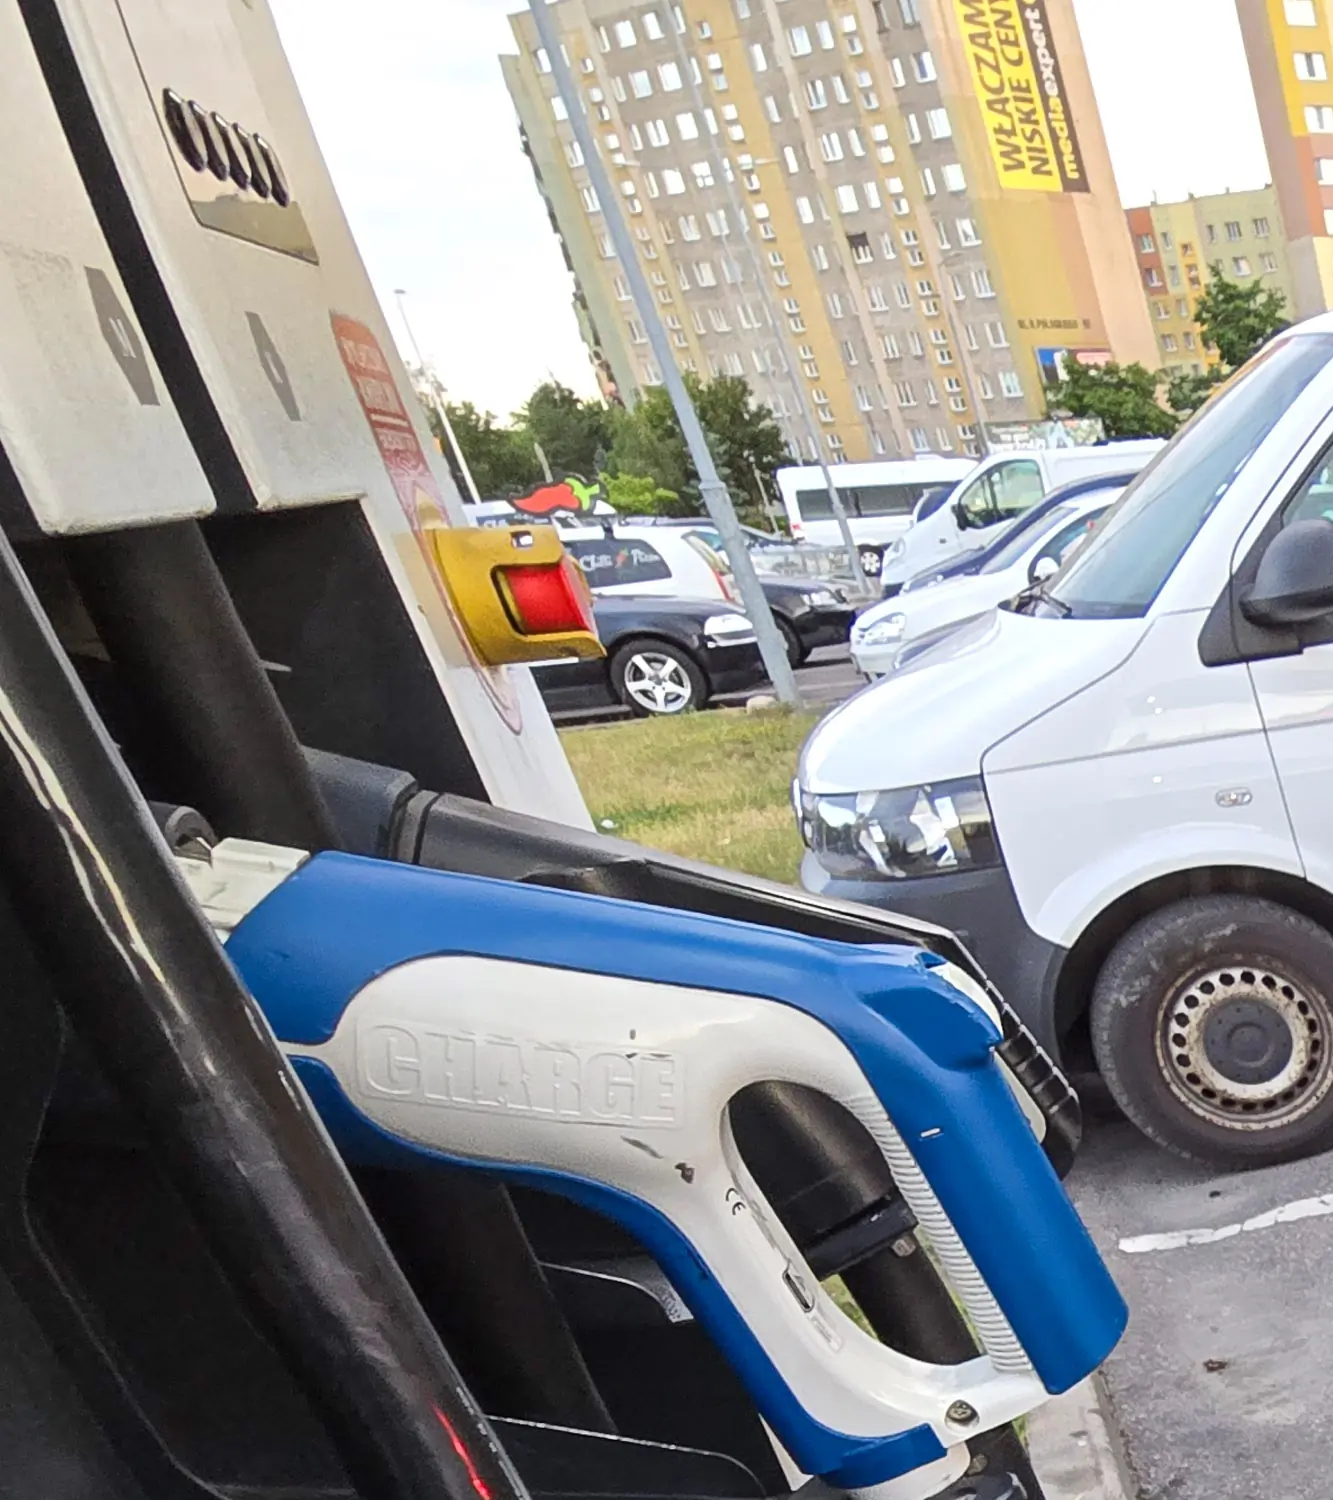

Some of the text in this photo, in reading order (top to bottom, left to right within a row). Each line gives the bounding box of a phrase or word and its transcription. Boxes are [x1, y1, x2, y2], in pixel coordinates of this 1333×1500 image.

[1008, 77, 1054, 177] NISKIE
[1024, 8, 1081, 180] mediaexpert
[364, 1025, 676, 1123] CHARGE
